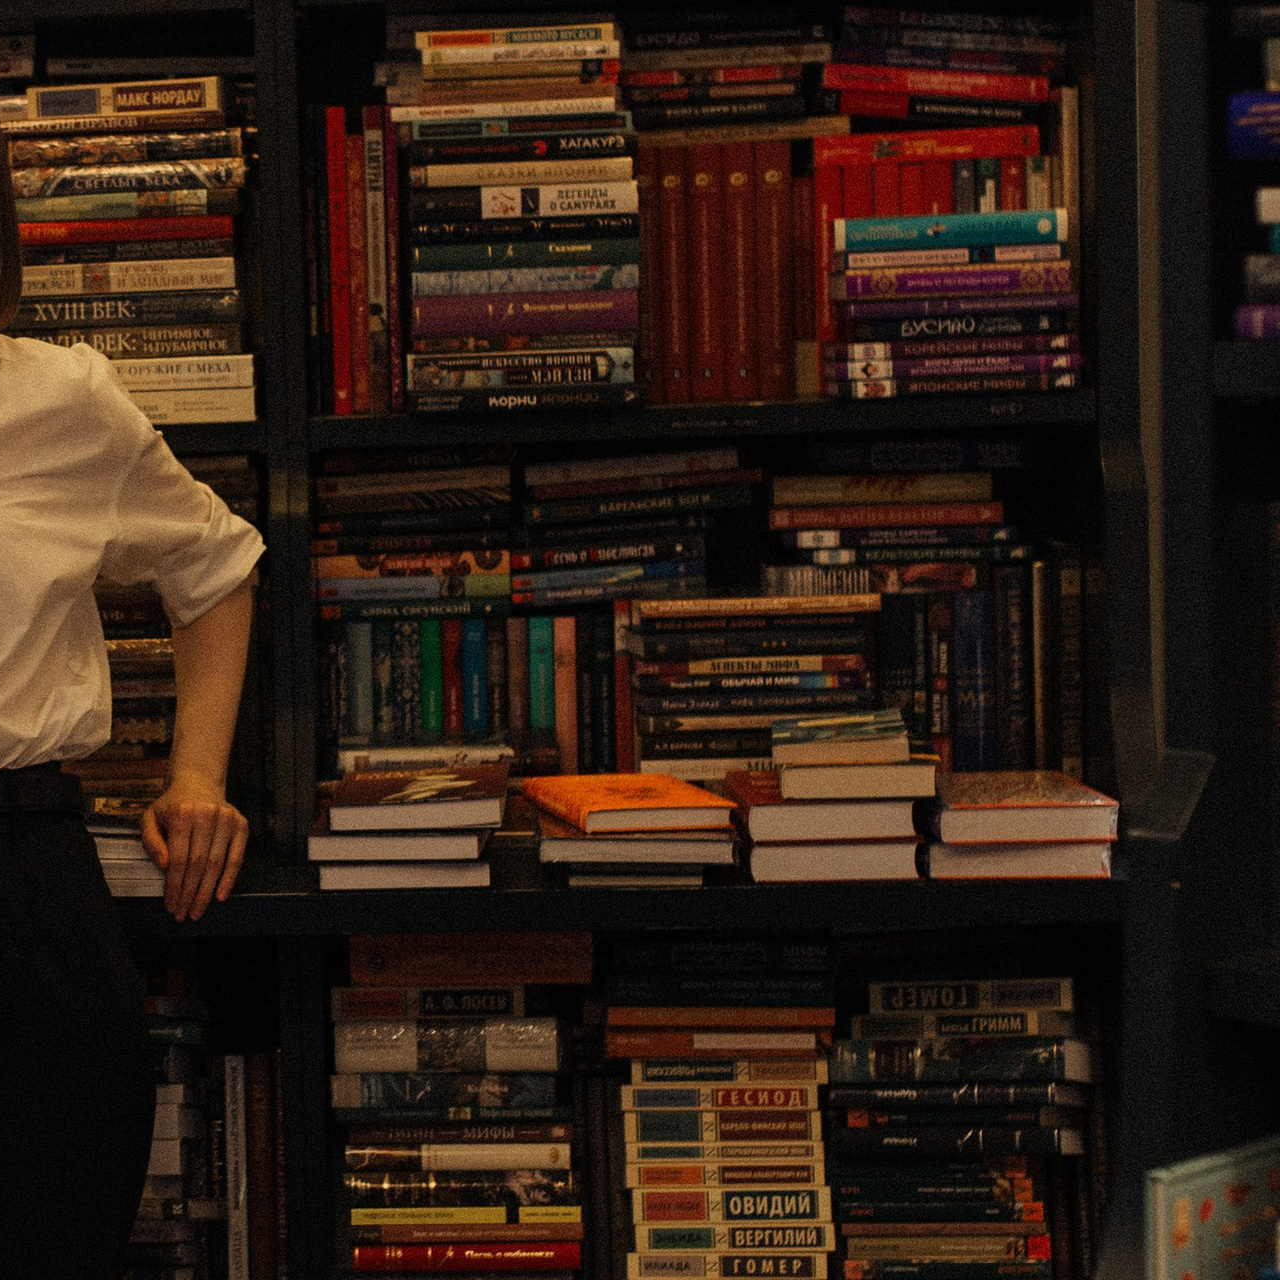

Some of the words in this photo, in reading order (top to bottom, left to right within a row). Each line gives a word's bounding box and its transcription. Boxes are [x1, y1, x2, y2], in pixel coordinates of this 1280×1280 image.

[117, 94, 151, 108] МАКС
[153, 89, 202, 106] НОРДАУ
[556, 188, 608, 201] ЛЕГЕНДЫ
[558, 199, 616, 212] САМУРАЯХ
[34, 302, 87, 321] XVIII
[92, 299, 137, 319] ВЕК:
[902, 316, 975, 338] БУСИДО
[489, 395, 538, 410] корни
[461, 994, 508, 1011] ЛОСЕВ
[891, 987, 969, 1008] ГОМЕР
[971, 1016, 1022, 1032] ГРИММ
[717, 1090, 802, 1108] ГЕСИОД
[463, 1126, 515, 1139] МИФЫ
[728, 1192, 811, 1219] ОВИДИЙ
[734, 1225, 818, 1246] ВЕРГИЛИЙ
[732, 1258, 803, 1274] ГОМЕР
